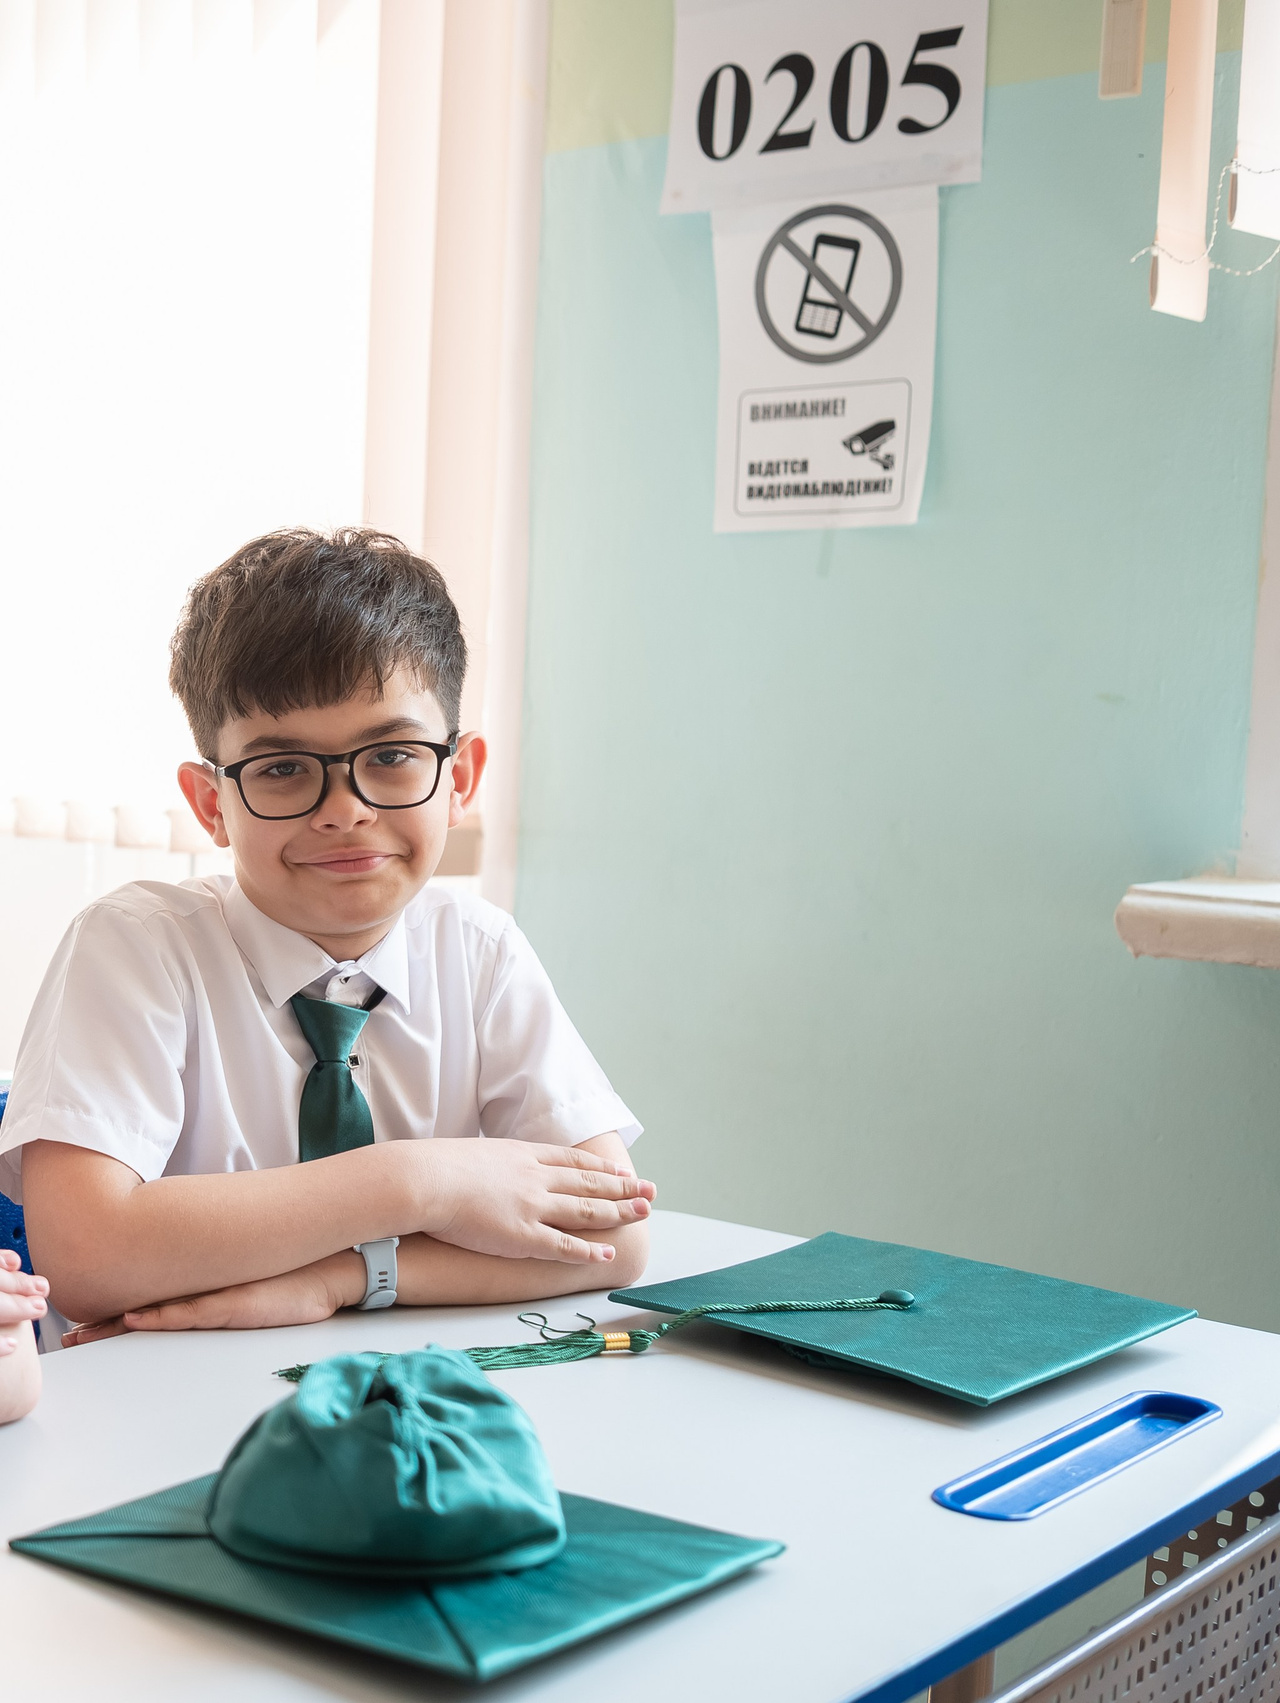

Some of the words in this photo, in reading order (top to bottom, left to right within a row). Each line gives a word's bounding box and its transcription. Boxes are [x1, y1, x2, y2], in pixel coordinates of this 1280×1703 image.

[696, 26, 964, 161] 0205
[749, 398, 846, 422] ВНИМАНИЕ!
[747, 459, 809, 477] ВЕДЕТСЯ
[746, 478, 893, 500] ВИДЕОНАБЛЮДЕНИЕ!
